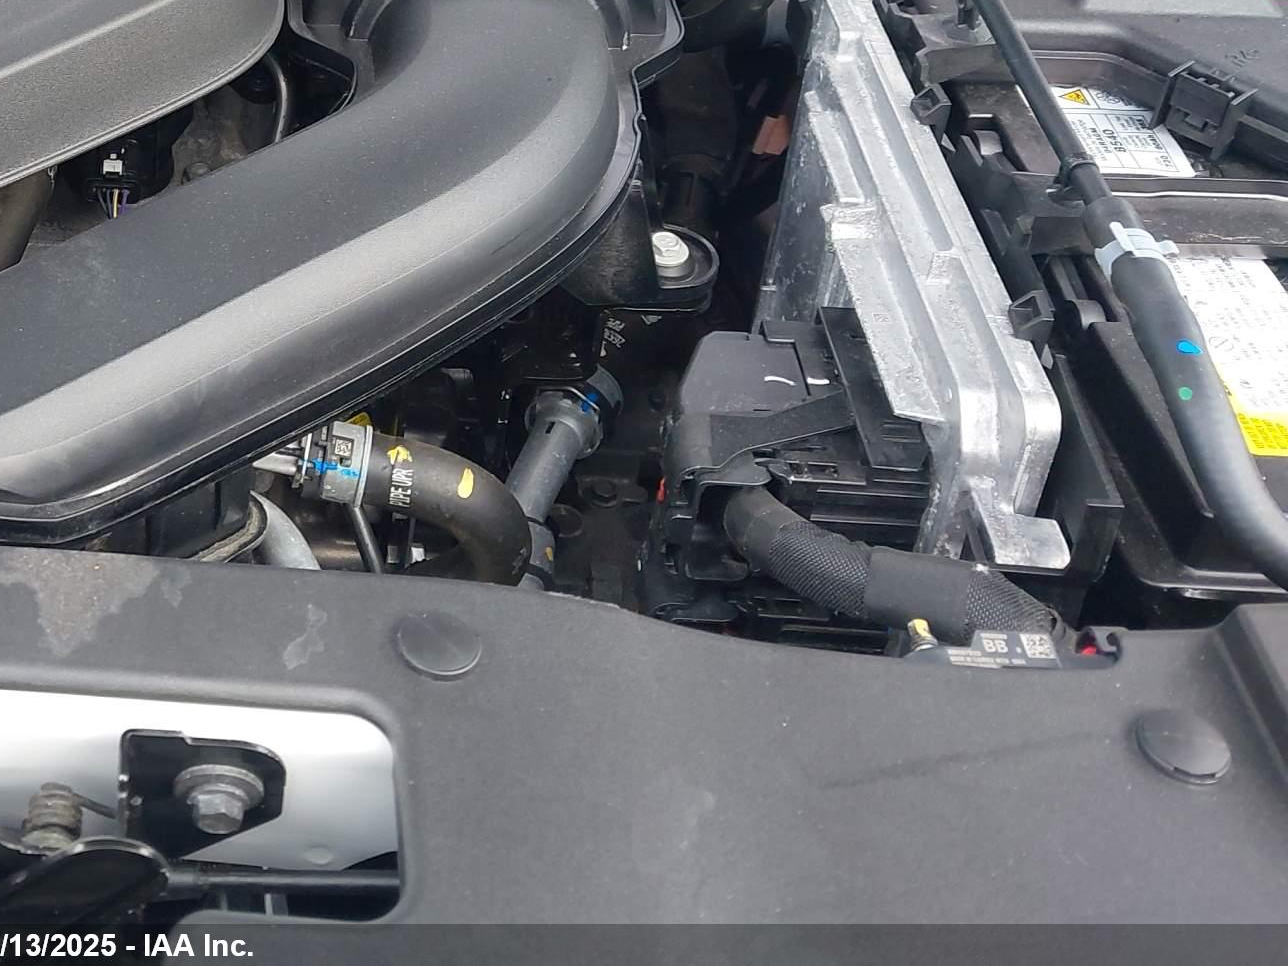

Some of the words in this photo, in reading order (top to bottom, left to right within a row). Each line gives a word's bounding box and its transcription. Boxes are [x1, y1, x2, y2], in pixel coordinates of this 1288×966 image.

[391, 468, 414, 487] UPR
[389, 486, 411, 508] PIPE
[982, 639, 1008, 653] BB
